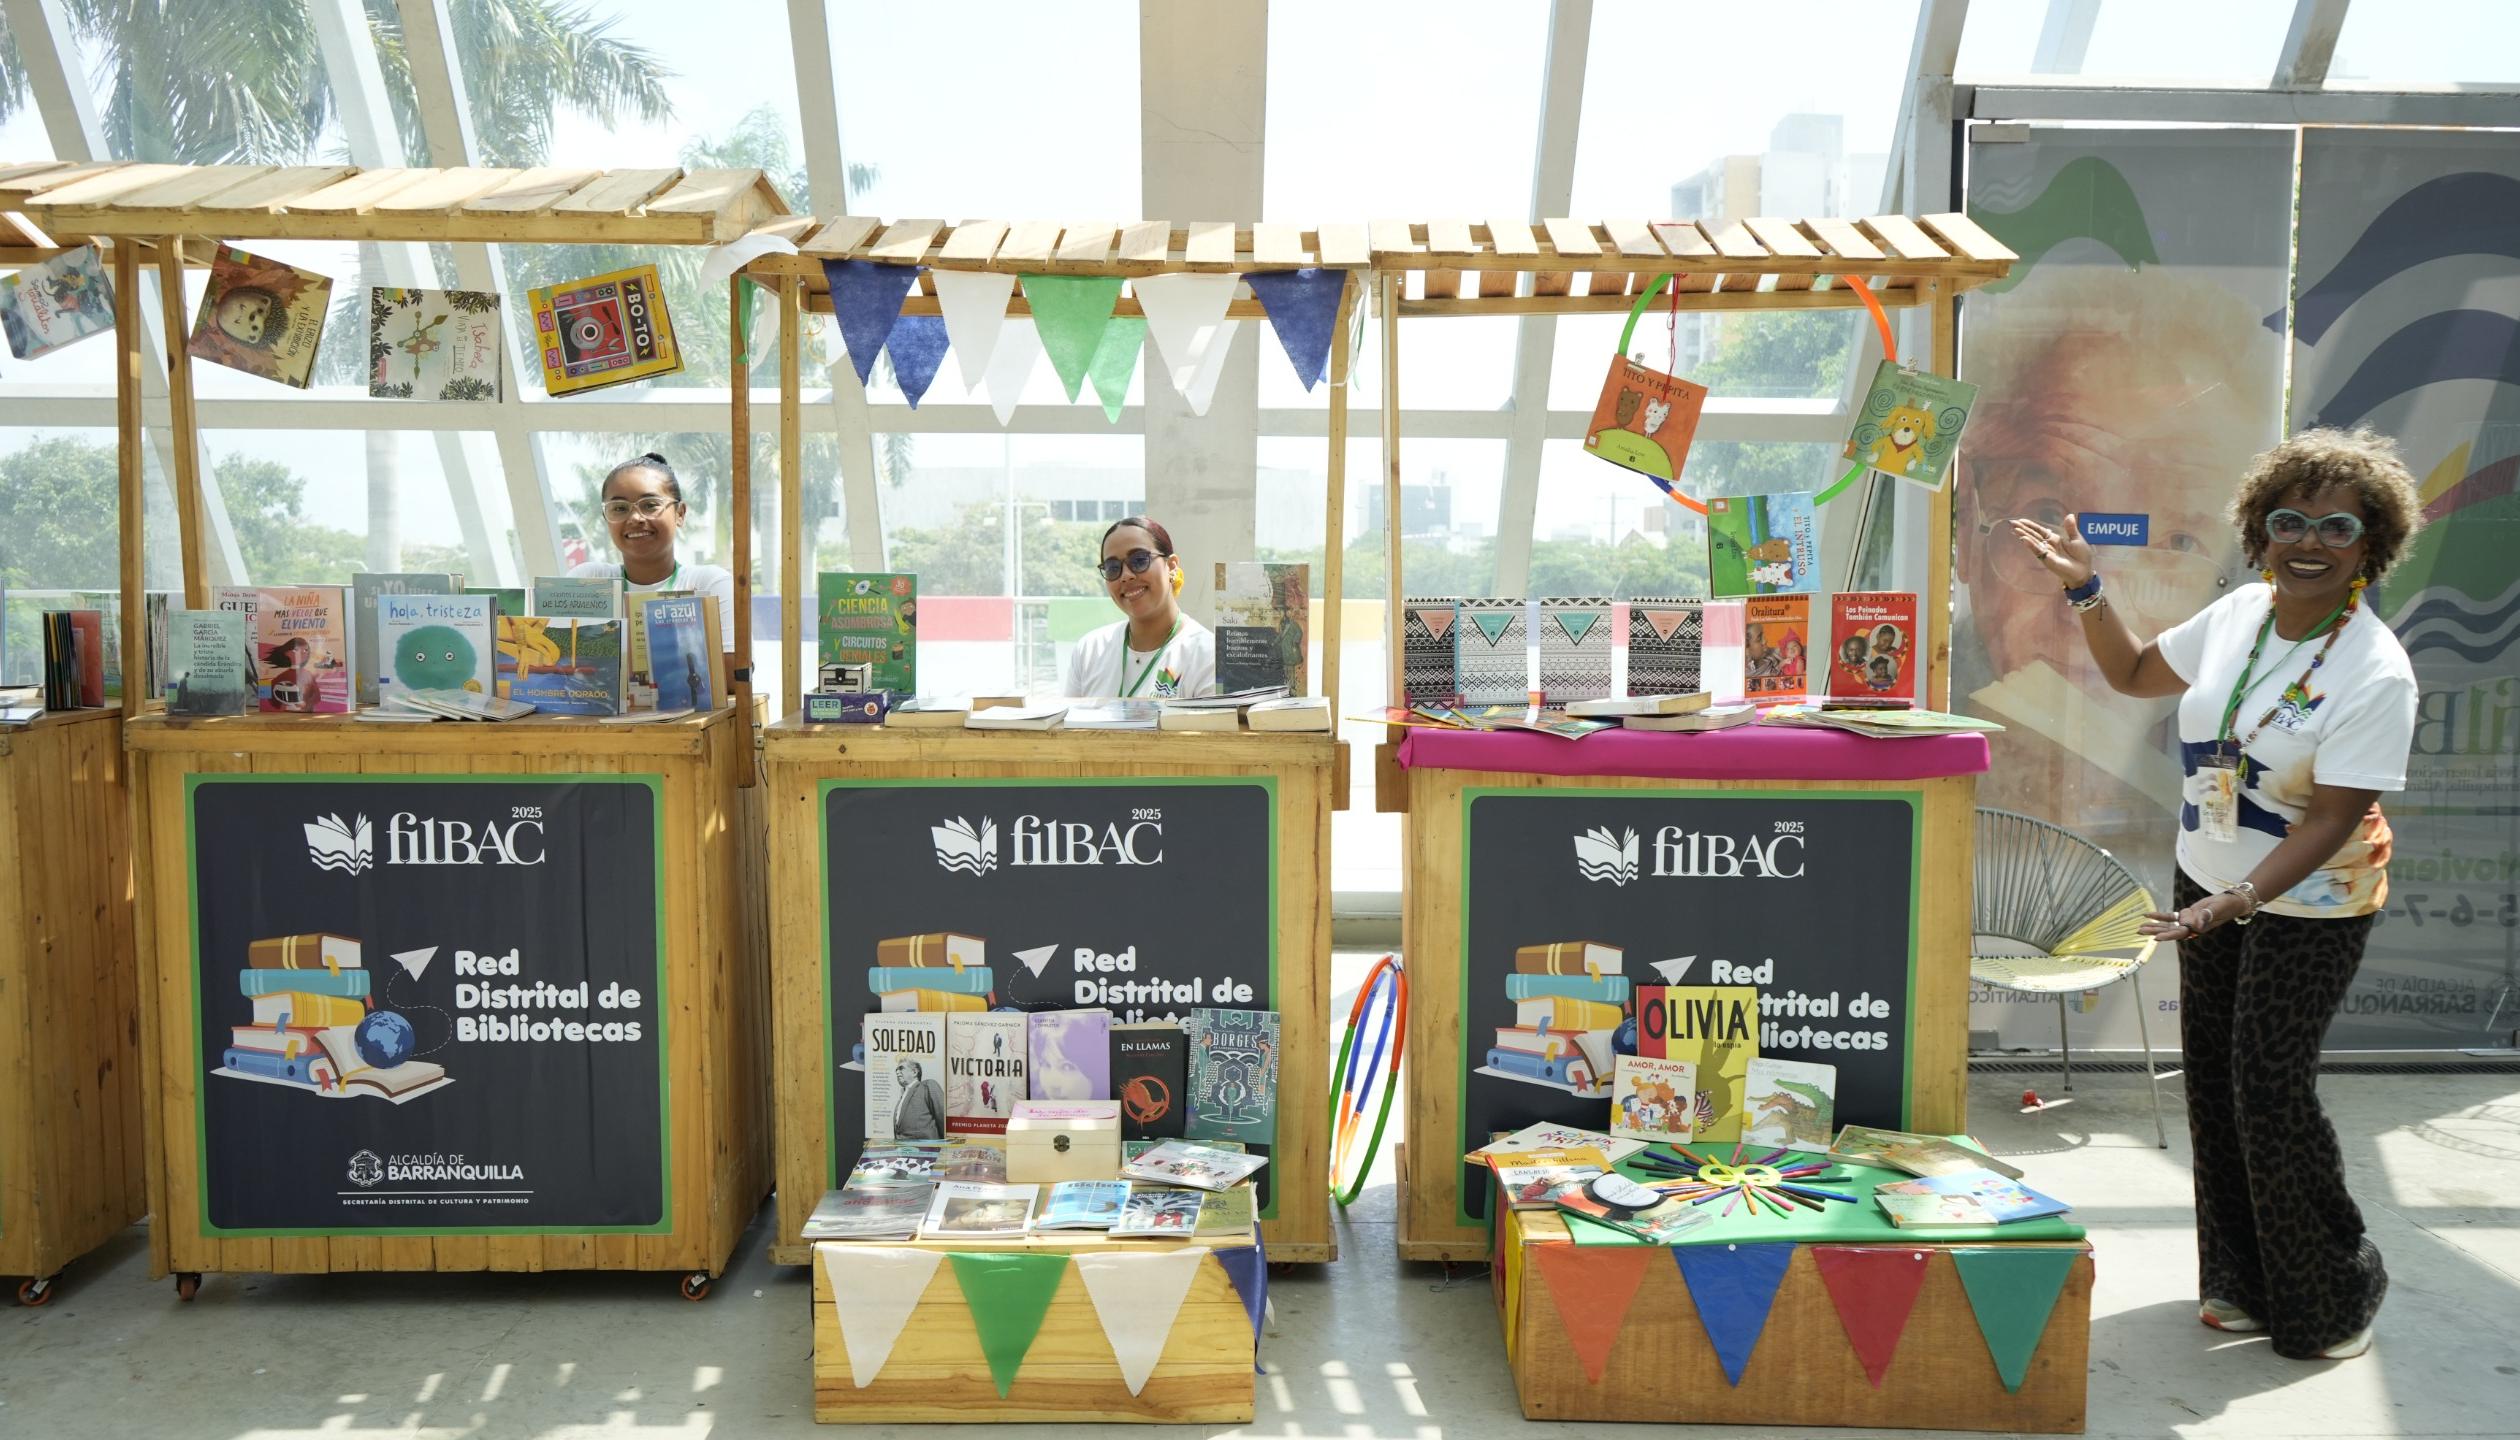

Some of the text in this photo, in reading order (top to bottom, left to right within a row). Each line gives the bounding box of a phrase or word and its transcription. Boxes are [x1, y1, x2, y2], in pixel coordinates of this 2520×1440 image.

[627, 293, 650, 347] BO-TO
[1623, 367, 1645, 384] TITO
[1648, 378, 1656, 387] Y
[2087, 522, 2139, 537] EMPUJE
[1795, 530, 1806, 576] INTRUSO
[314, 608, 328, 616] QUE
[390, 601, 423, 620] hola,
[426, 601, 482, 619] tristeza
[554, 600, 568, 608] LOS
[569, 600, 608, 609] ARMENIOS
[654, 602, 696, 619] el azul
[838, 597, 889, 614] CIENCIA
[1751, 605, 1785, 617] Oralitura
[1846, 605, 1888, 614] Los Peinados
[281, 618, 325, 630] EL VIENTO
[831, 615, 893, 630] ASOMBROSA
[1845, 613, 1909, 622] También Comunican
[834, 635, 887, 651] Y CIRCUITOS
[513, 688, 608, 699] EL HOMBRE DORADO
[812, 700, 839, 709] LEER
[511, 806, 543, 819] 2025
[1131, 808, 1162, 820] 2025
[1774, 821, 1805, 833] 2025
[386, 812, 545, 866] filBAC
[1010, 815, 1163, 866] filBAC
[1651, 825, 1805, 879] filBAC
[455, 948, 519, 976] Red
[1074, 945, 1136, 972] Red
[1711, 958, 1774, 984] Red
[456, 981, 641, 1009] Distrital de
[1074, 976, 1253, 1004] Distrital de
[1757, 989, 1890, 1018] trital de
[457, 1013, 642, 1042] Bibliotecas
[1643, 997, 1750, 1041] OLIVIA
[872, 1028, 936, 1054] SOLEDAD
[1212, 1032, 1257, 1049] BORGES
[1757, 1021, 1888, 1050] liotecas
[1121, 1042, 1171, 1052] EN LLAMAS
[950, 1057, 1023, 1078] VICTORIA
[1627, 1061, 1685, 1073] AMOR, AMOR
[951, 1121, 972, 1129] PREMIO
[388, 1152, 464, 1166] ALCALDÍA DE
[387, 1164, 524, 1181] BARRANQUILLA
